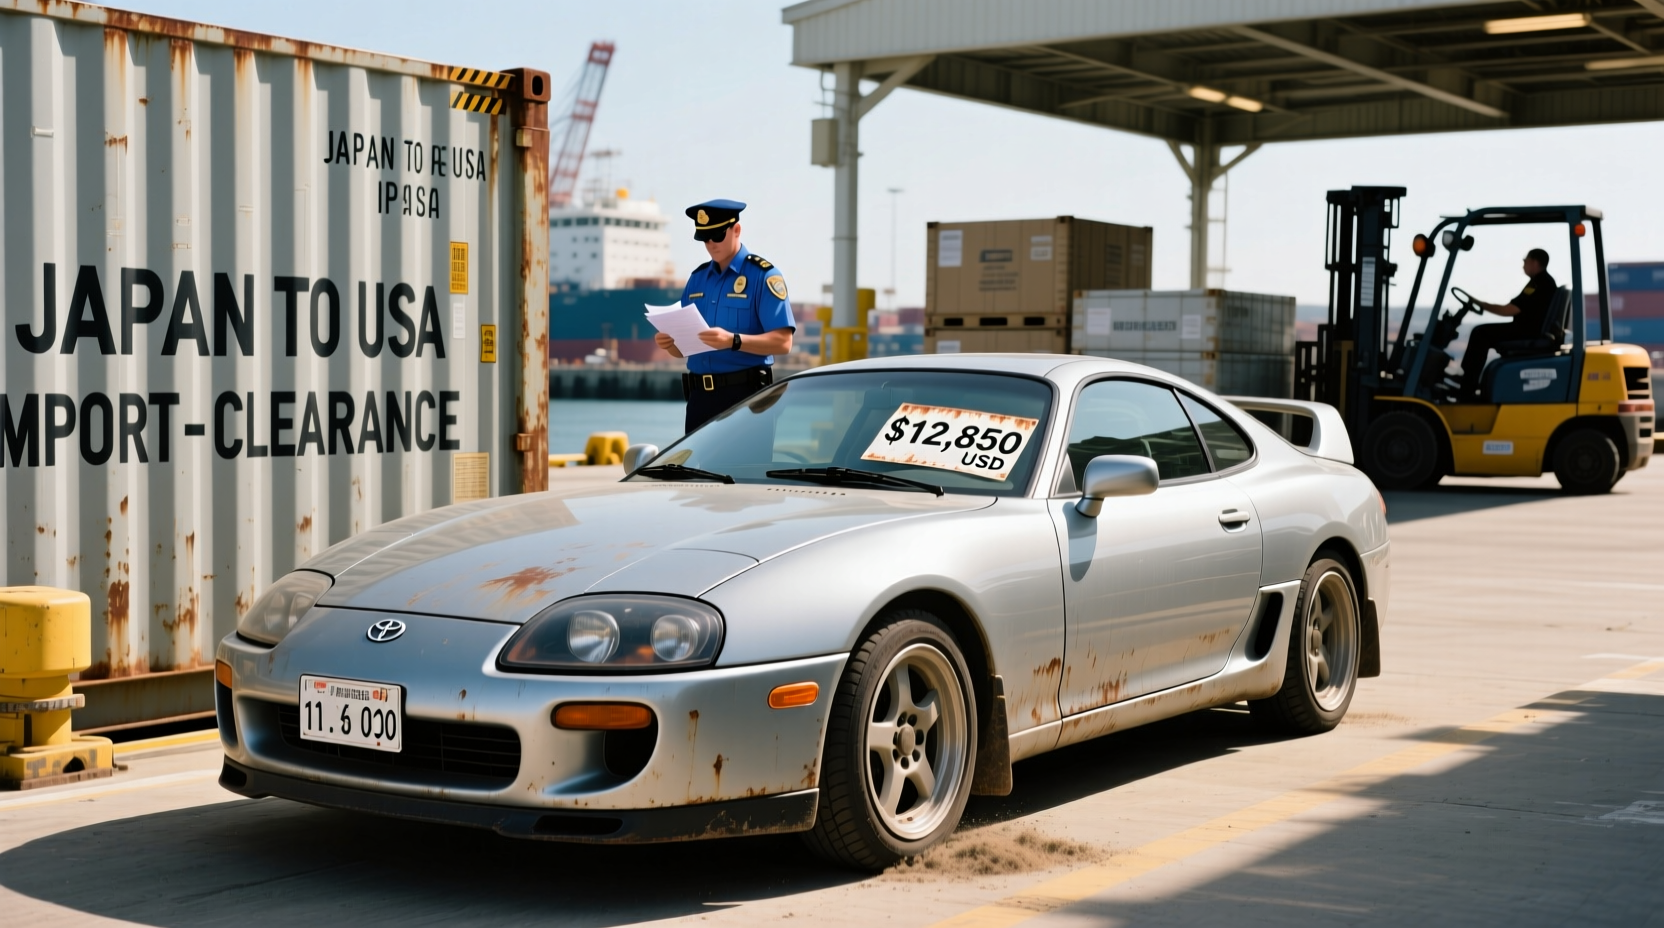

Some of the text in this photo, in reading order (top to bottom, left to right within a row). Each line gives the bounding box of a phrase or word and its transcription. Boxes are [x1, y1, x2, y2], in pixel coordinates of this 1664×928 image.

[323, 130, 395, 170] JAPAN
[403, 140, 423, 174] TO
[452, 146, 487, 182] USA
[15, 262, 255, 357] JAPAN
[273, 275, 341, 358] TO
[357, 280, 447, 359] USA
[884, 415, 1023, 455] $12,850
[961, 451, 1005, 471] USD
